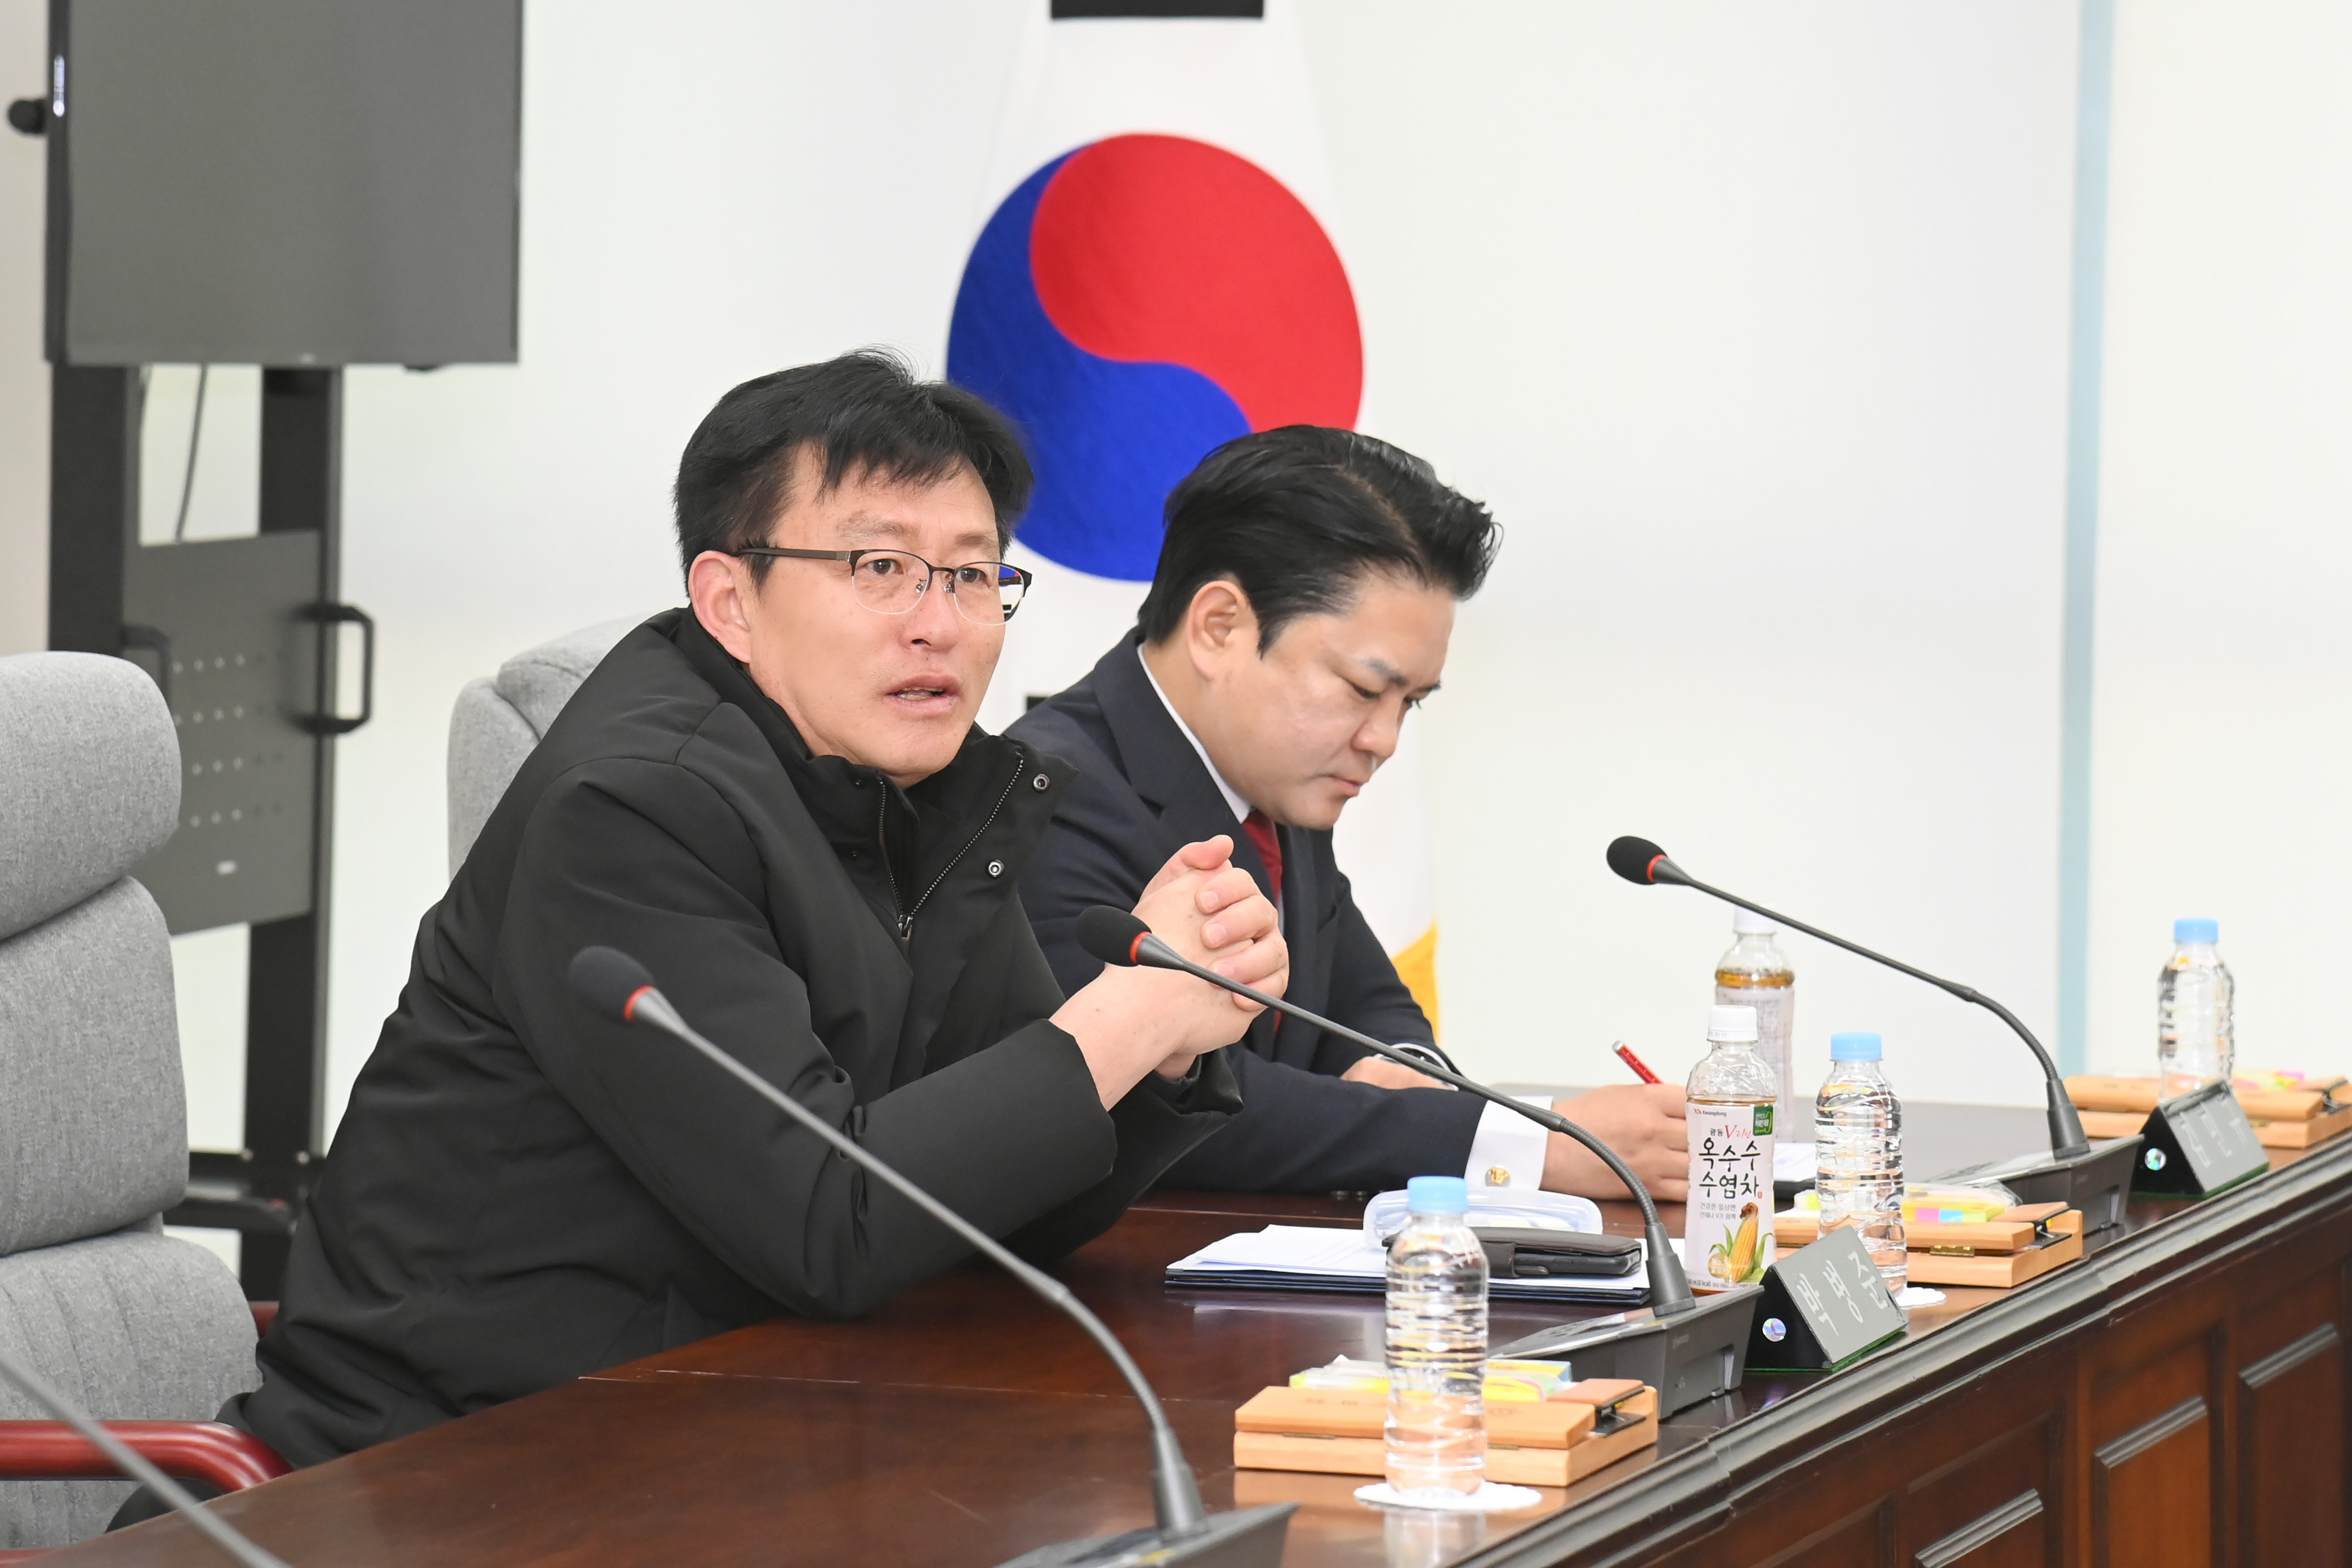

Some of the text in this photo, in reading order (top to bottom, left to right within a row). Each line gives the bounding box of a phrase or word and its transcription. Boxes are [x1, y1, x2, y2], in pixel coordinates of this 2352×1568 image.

[1710, 1128, 1723, 1137] 광동
[1698, 1137, 1761, 1172] 옥수수
[1699, 1171, 1759, 1199] 수염차
